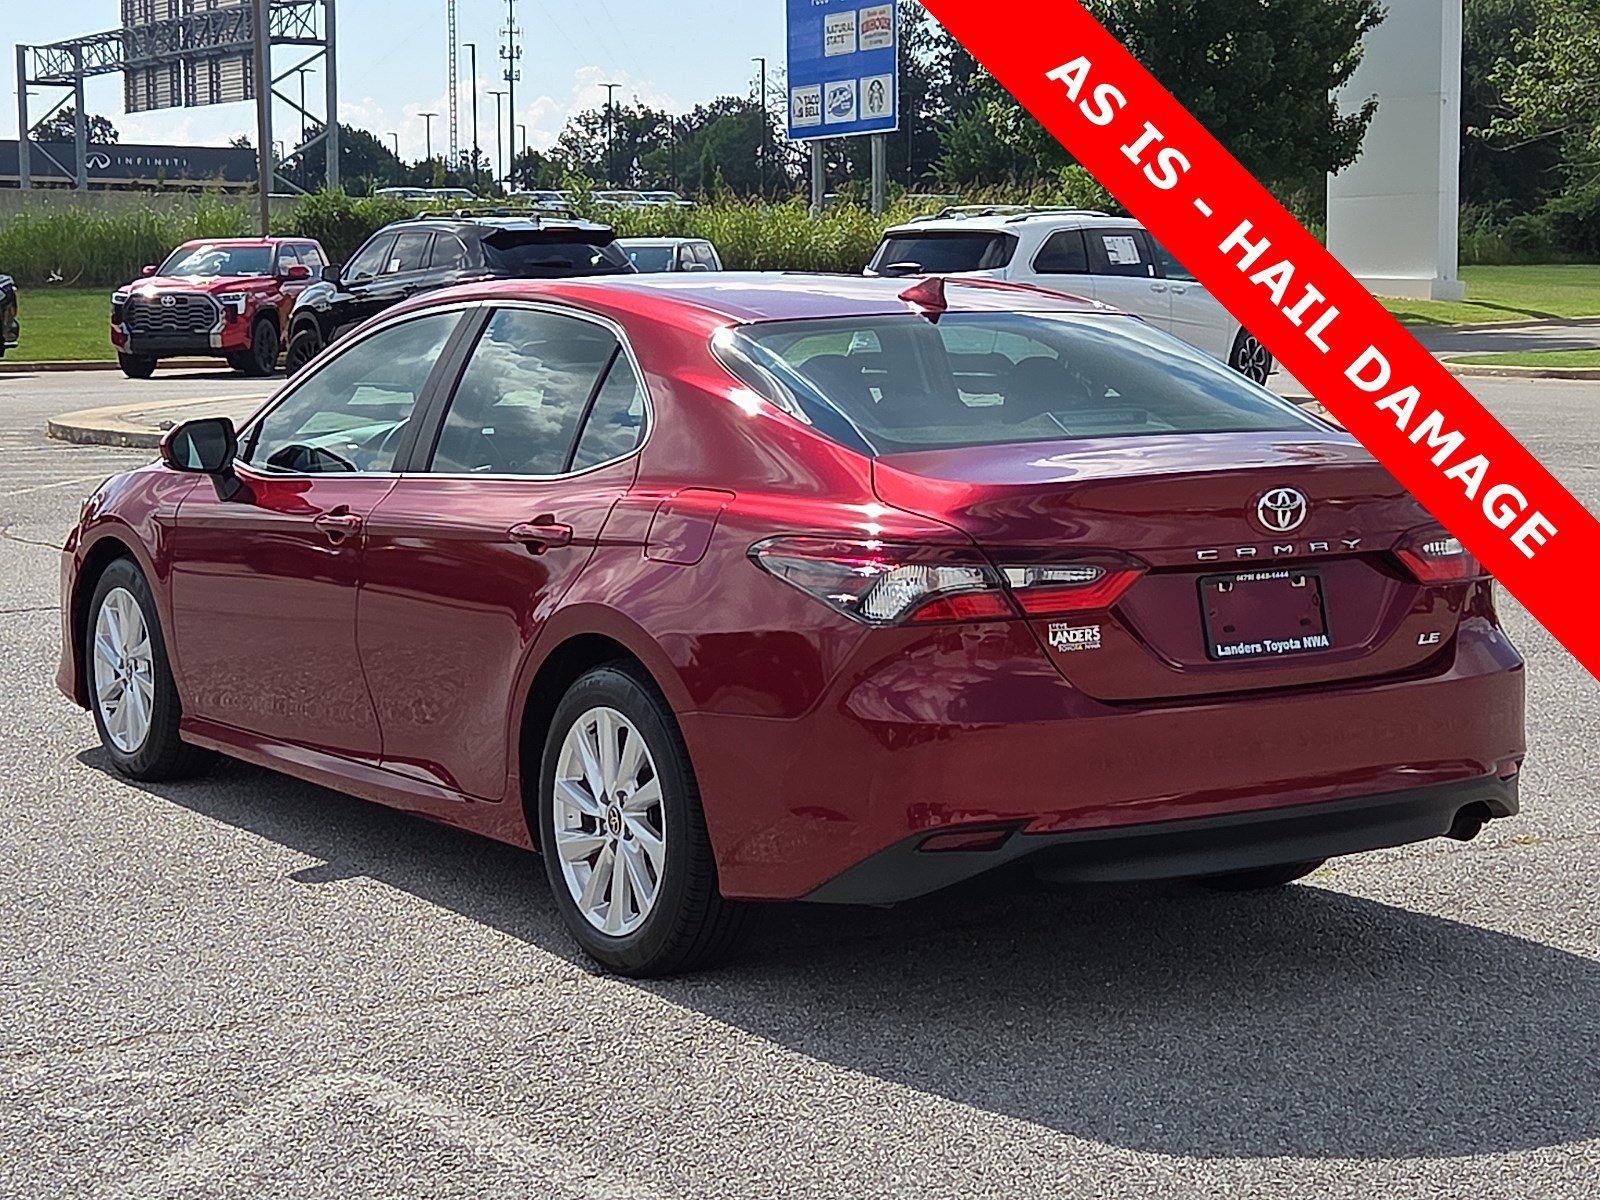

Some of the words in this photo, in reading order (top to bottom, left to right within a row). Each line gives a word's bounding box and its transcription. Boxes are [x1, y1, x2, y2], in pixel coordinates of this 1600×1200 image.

[826, 22, 855, 34] NATURAL
[826, 35, 845, 45] STATE
[804, 94, 820, 106] TACO
[804, 105, 820, 118] BELL
[117, 157, 188, 166] INFINITI
[1196, 538, 1362, 561] CAMRY
[1048, 627, 1101, 646] LANDERS
[1418, 632, 1441, 645] LE
[1216, 642, 1263, 657] Landers
[1263, 638, 1301, 653] Toyota
[1302, 634, 1330, 648] NWA
